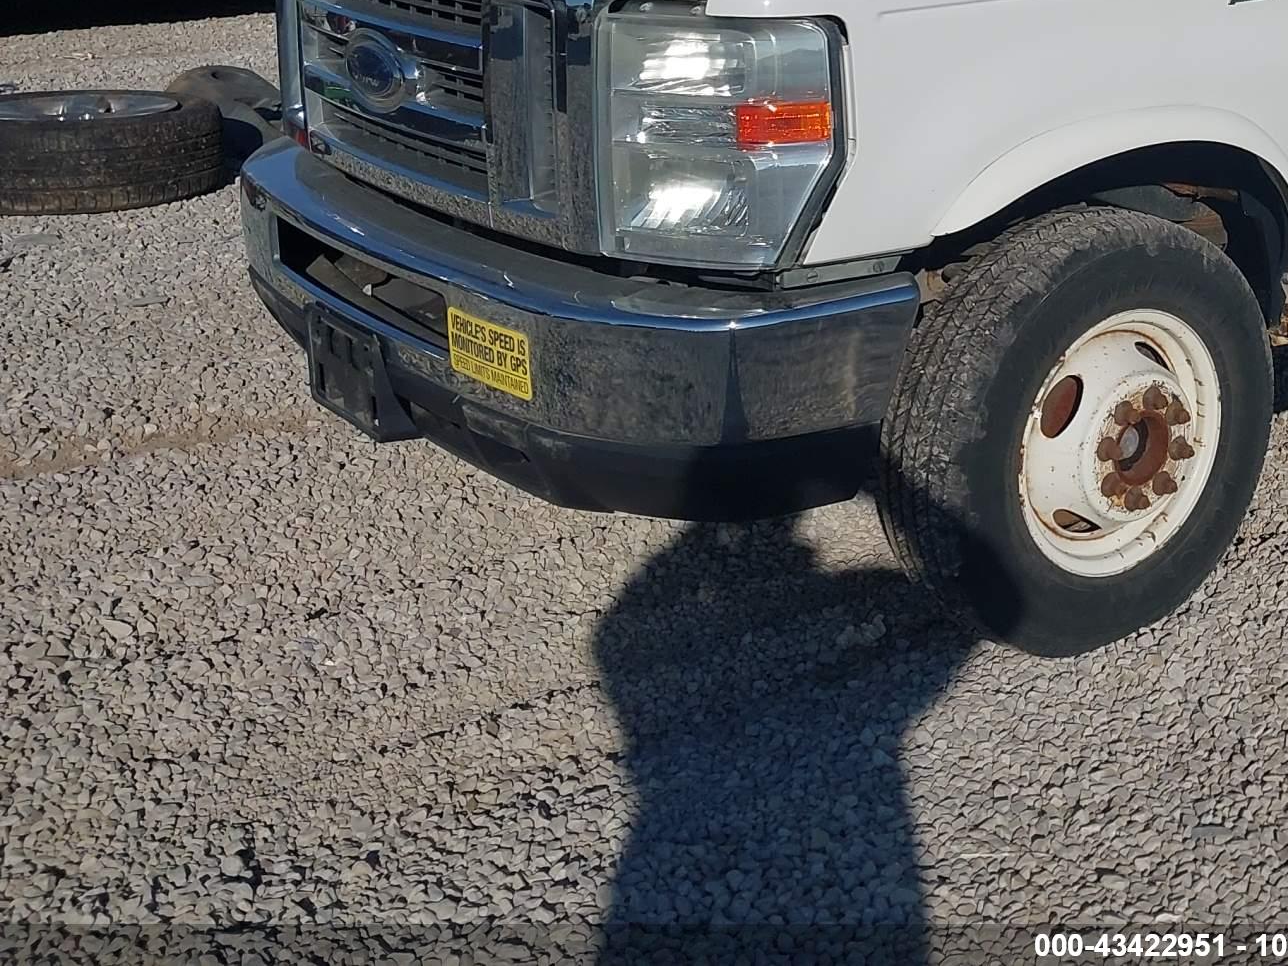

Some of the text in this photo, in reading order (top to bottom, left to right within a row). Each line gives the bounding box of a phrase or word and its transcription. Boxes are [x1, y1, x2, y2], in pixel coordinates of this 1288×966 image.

[451, 312, 526, 356] VEHICLE'S SPEED IS
[451, 331, 528, 376] MONITORED BY GPS
[453, 353, 528, 394] SPEED LIMITS MAINTAINED
